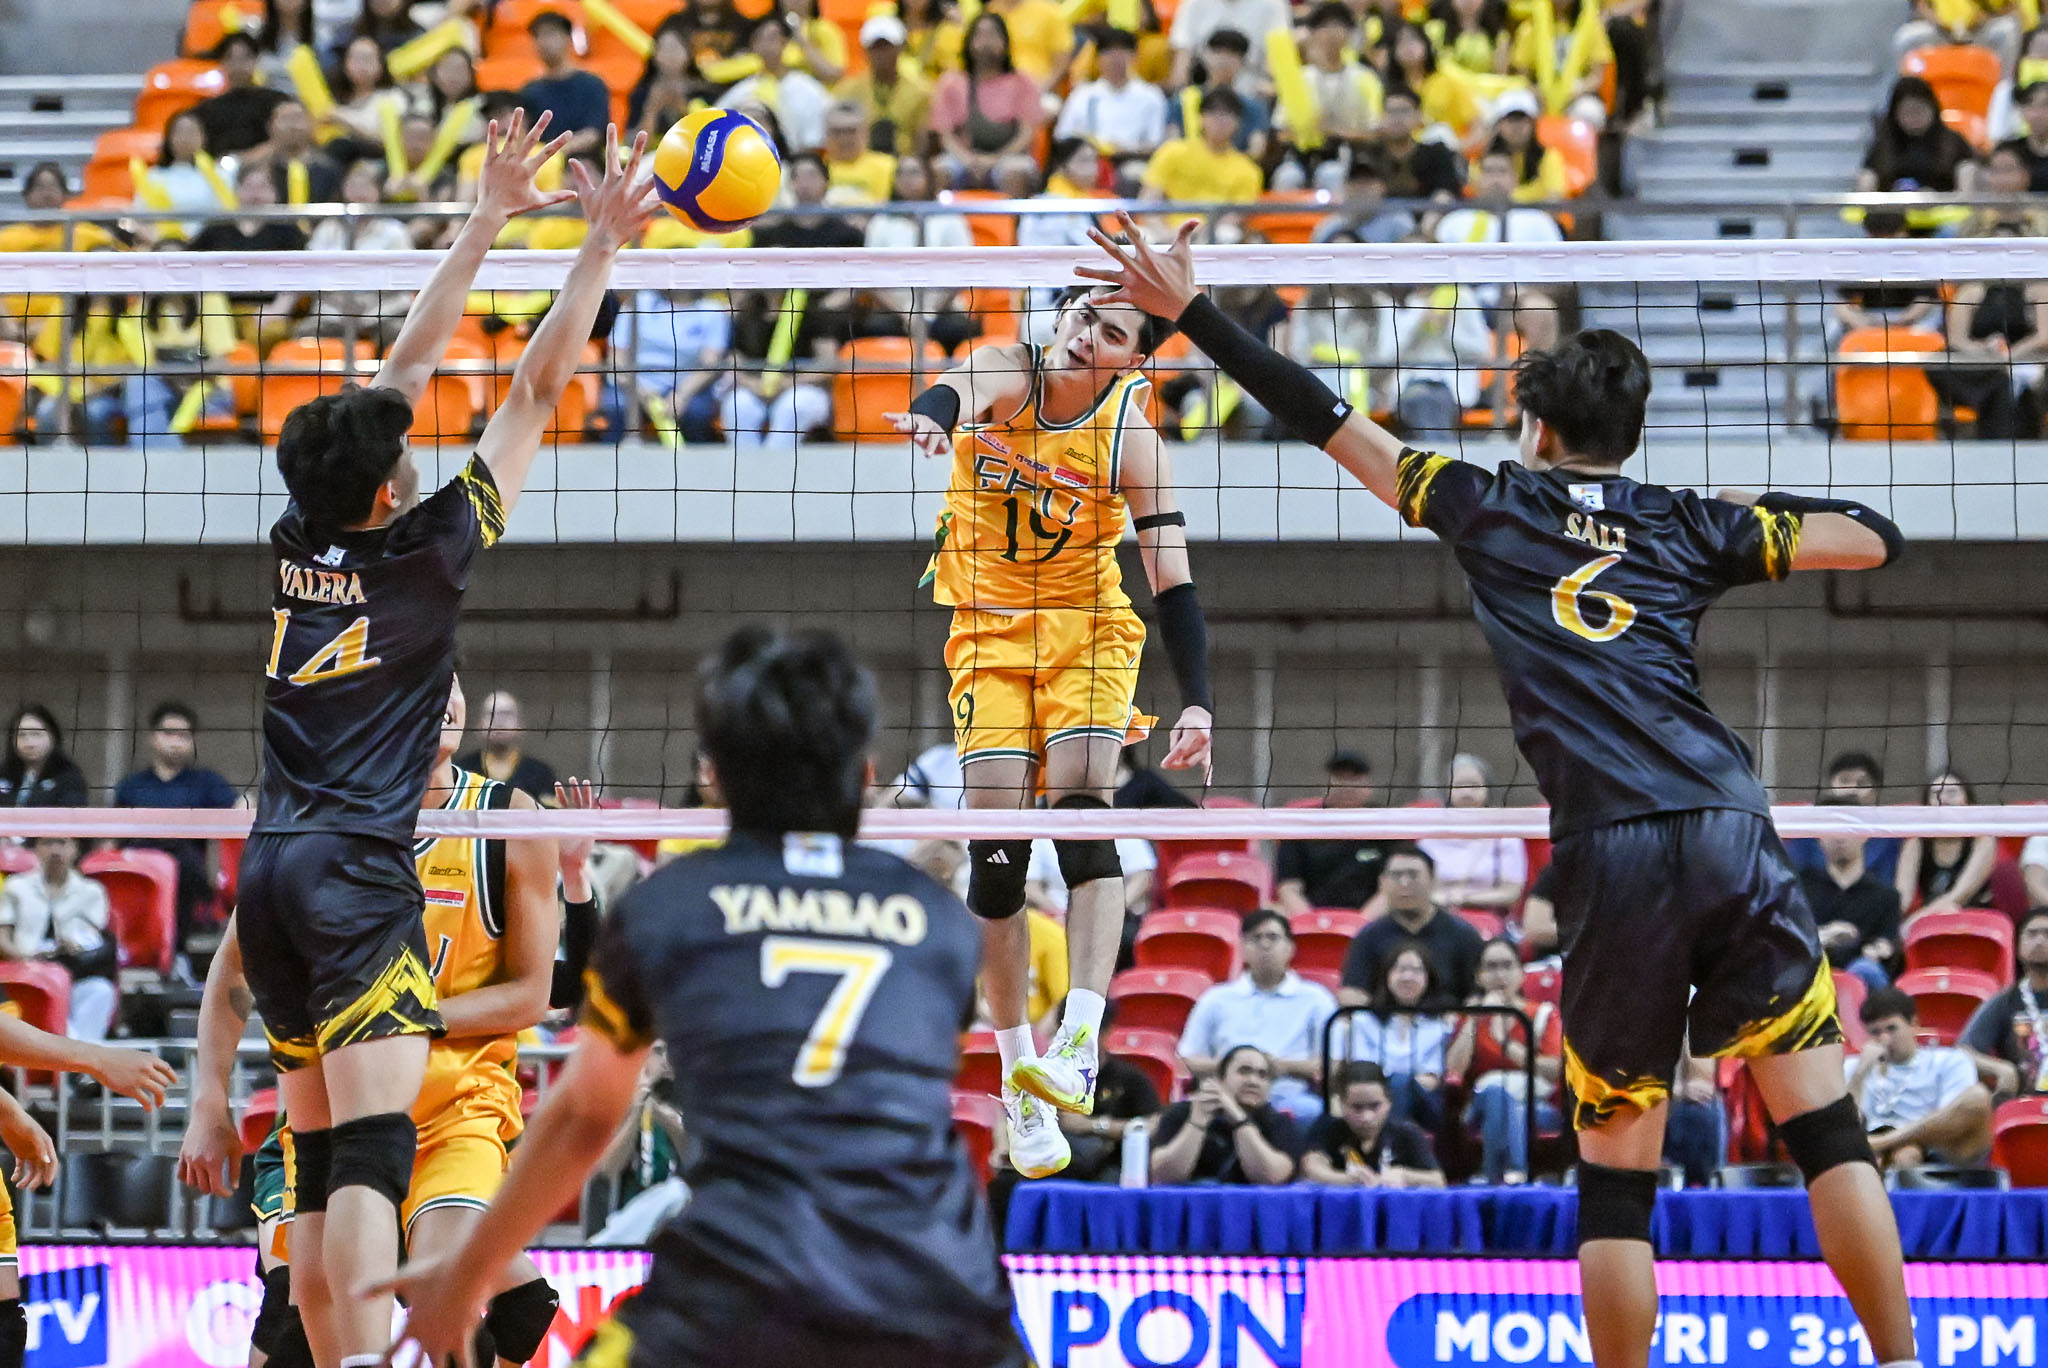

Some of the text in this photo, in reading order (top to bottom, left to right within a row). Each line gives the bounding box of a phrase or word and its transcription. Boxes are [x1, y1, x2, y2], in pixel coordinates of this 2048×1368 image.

[1000, 496, 1073, 563] 19
[1564, 512, 1628, 553] SALI
[280, 558, 368, 605] VALERA
[1550, 553, 1638, 642] 6
[265, 606, 382, 686] 14
[708, 884, 929, 947] YAMBAO
[760, 934, 894, 1088] 7
[1051, 1289, 1304, 1368] PON
[1937, 1314, 2036, 1367] PM
